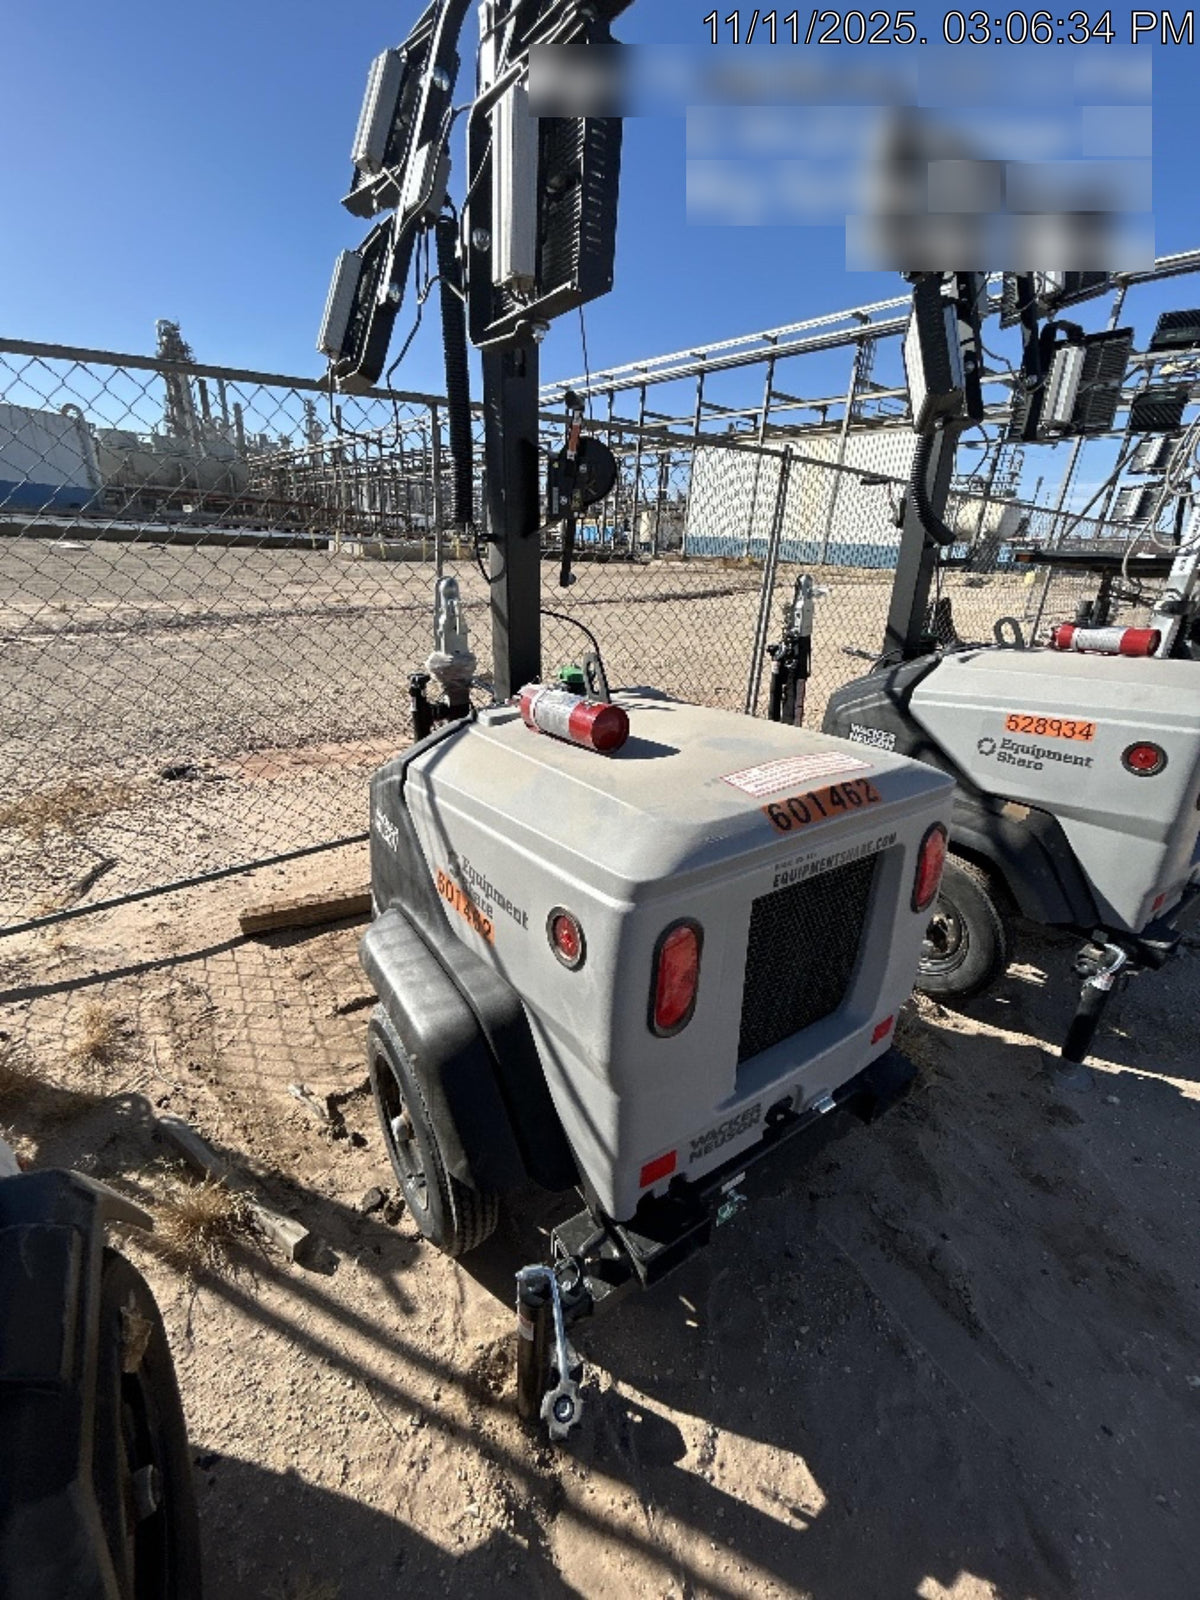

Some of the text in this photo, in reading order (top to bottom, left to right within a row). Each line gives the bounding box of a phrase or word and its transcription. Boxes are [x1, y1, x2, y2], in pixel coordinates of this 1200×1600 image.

[1007, 714, 1093, 740] 528934
[997, 751, 1044, 771] Share
[999, 737, 1094, 768] Equipment
[767, 778, 879, 831] 601462
[773, 832, 897, 887] EQUIPMENTSHARE.COM
[461, 855, 529, 931] Equipment
[688, 1113, 761, 1164] NEUSON
[689, 1102, 762, 1150] WACKER
